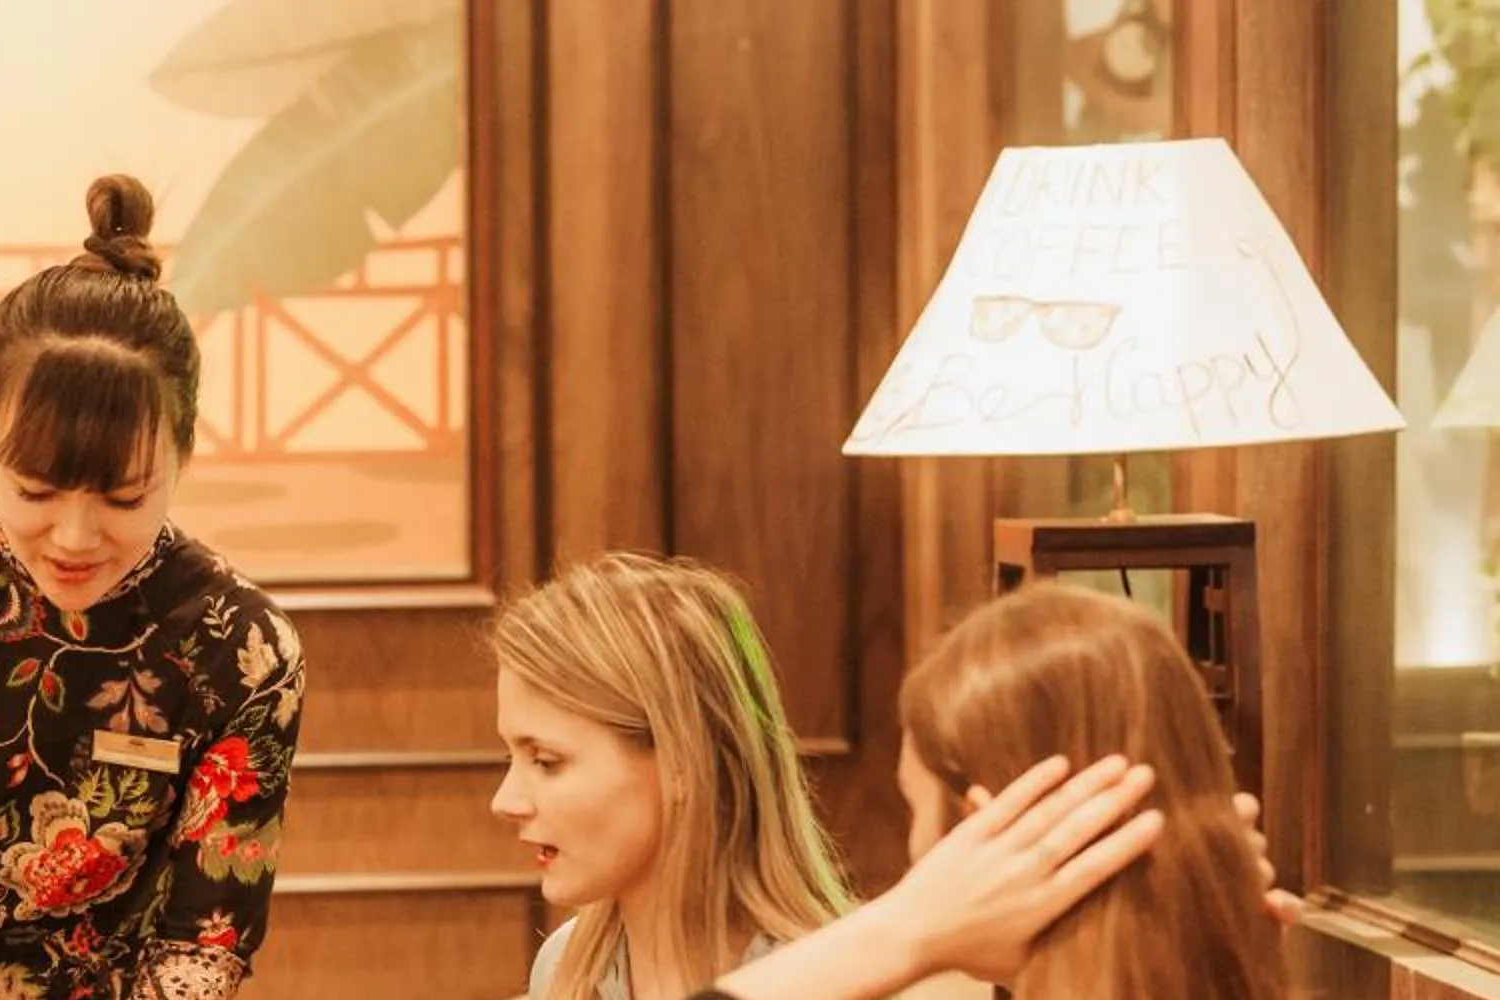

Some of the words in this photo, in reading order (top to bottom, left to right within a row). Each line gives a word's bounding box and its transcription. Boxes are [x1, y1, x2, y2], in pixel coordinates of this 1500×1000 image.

[996, 156, 1168, 218] DRINK
[963, 218, 1191, 281] COFFEE
[898, 352, 1007, 433] Be
[1049, 328, 1306, 441] Happy
